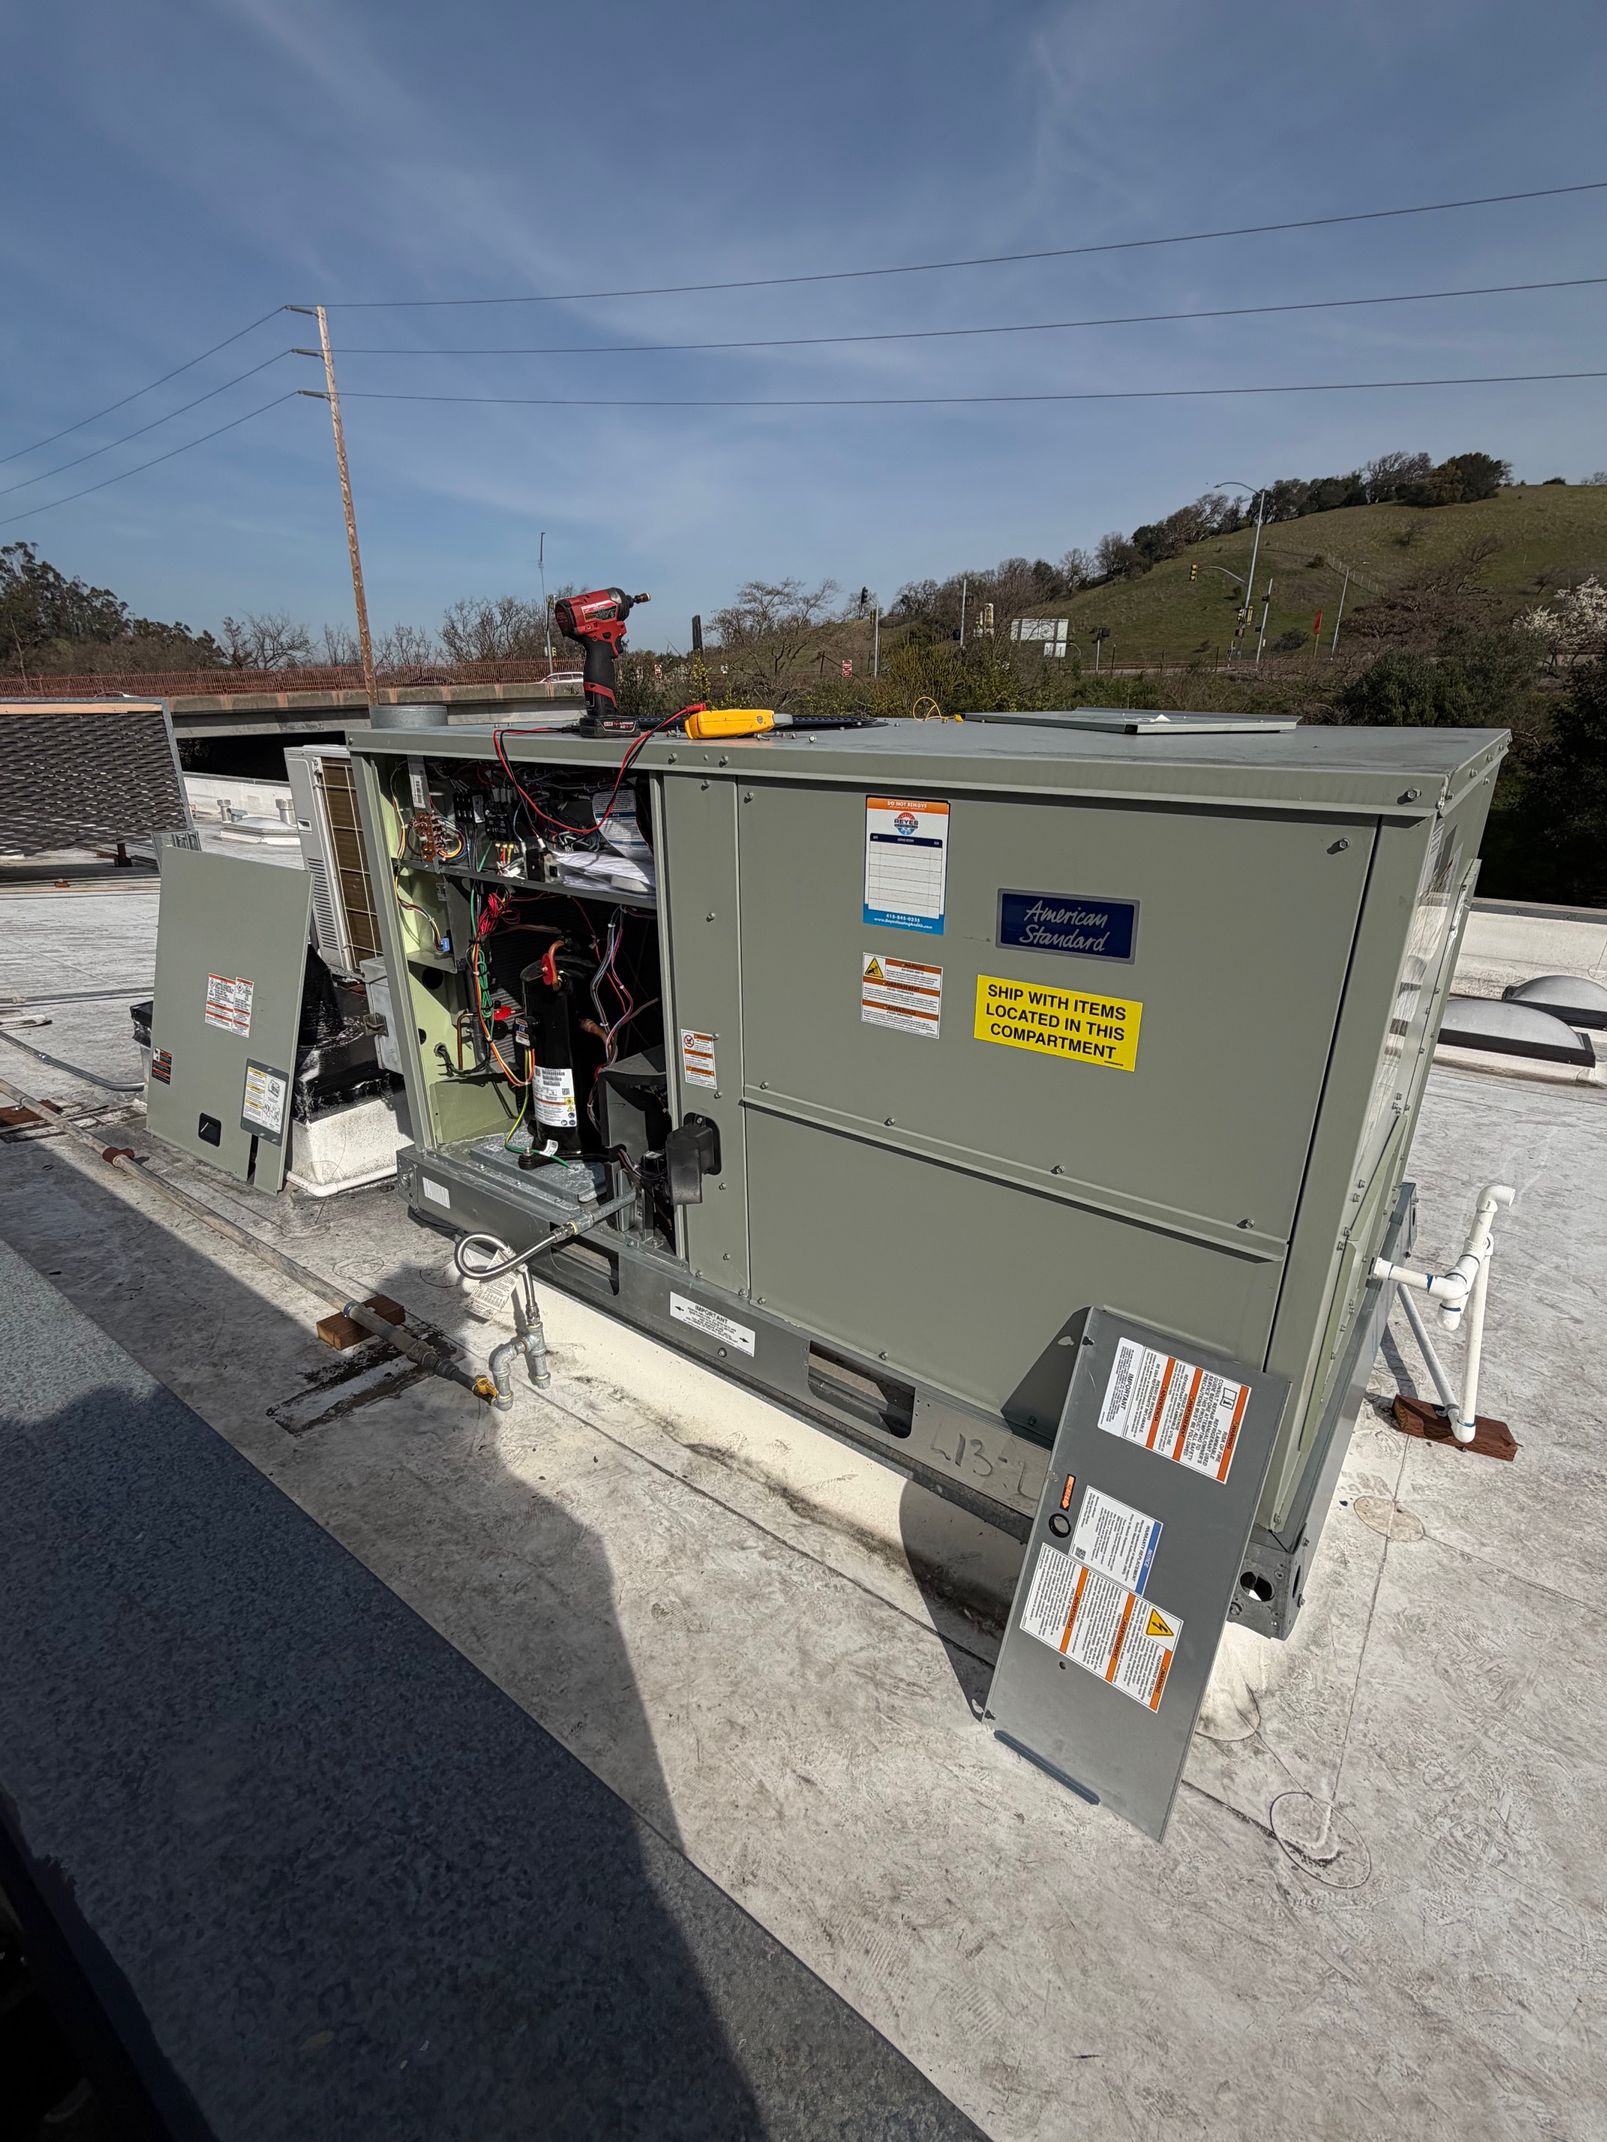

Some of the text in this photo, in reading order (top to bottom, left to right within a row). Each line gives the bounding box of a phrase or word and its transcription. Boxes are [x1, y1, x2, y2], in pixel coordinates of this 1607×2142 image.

[1024, 900, 1108, 928] American
[1019, 924, 1111, 951] Standard
[988, 984, 1126, 1021] SHIP WITH ITEMS
[986, 1003, 1125, 1041] LOCATED IN THIS
[990, 1023, 1116, 1059] COMPARTMENT
[695, 1305, 728, 1324] IMPORTANT
[1120, 1373, 1134, 1409] IMPORTANT
[1195, 1373, 1208, 1406] PRECAUTIONS
[1204, 1374, 1213, 1395] SERVICE
[1210, 1376, 1218, 1392] GUIDE
[1213, 1378, 1223, 1401] CONSULT
[1205, 1392, 1214, 1412] BEFORE
[1208, 1402, 1217, 1419] REPAIR
[1197, 1412, 1208, 1442] ATTEMPTING
[1206, 1418, 1218, 1452] REFRIGERANT
[1226, 1424, 1236, 1449] WARNING
[1187, 1442, 1195, 1460] SAFETY
[1209, 1429, 1221, 1459] FLAMMABLE
[1218, 1443, 1224, 1451] OF
[1140, 1525, 1150, 1549] WARRANTY
[1131, 1549, 1143, 1581] REPLACEMENT
[1143, 1548, 1152, 1568] NOTICE
